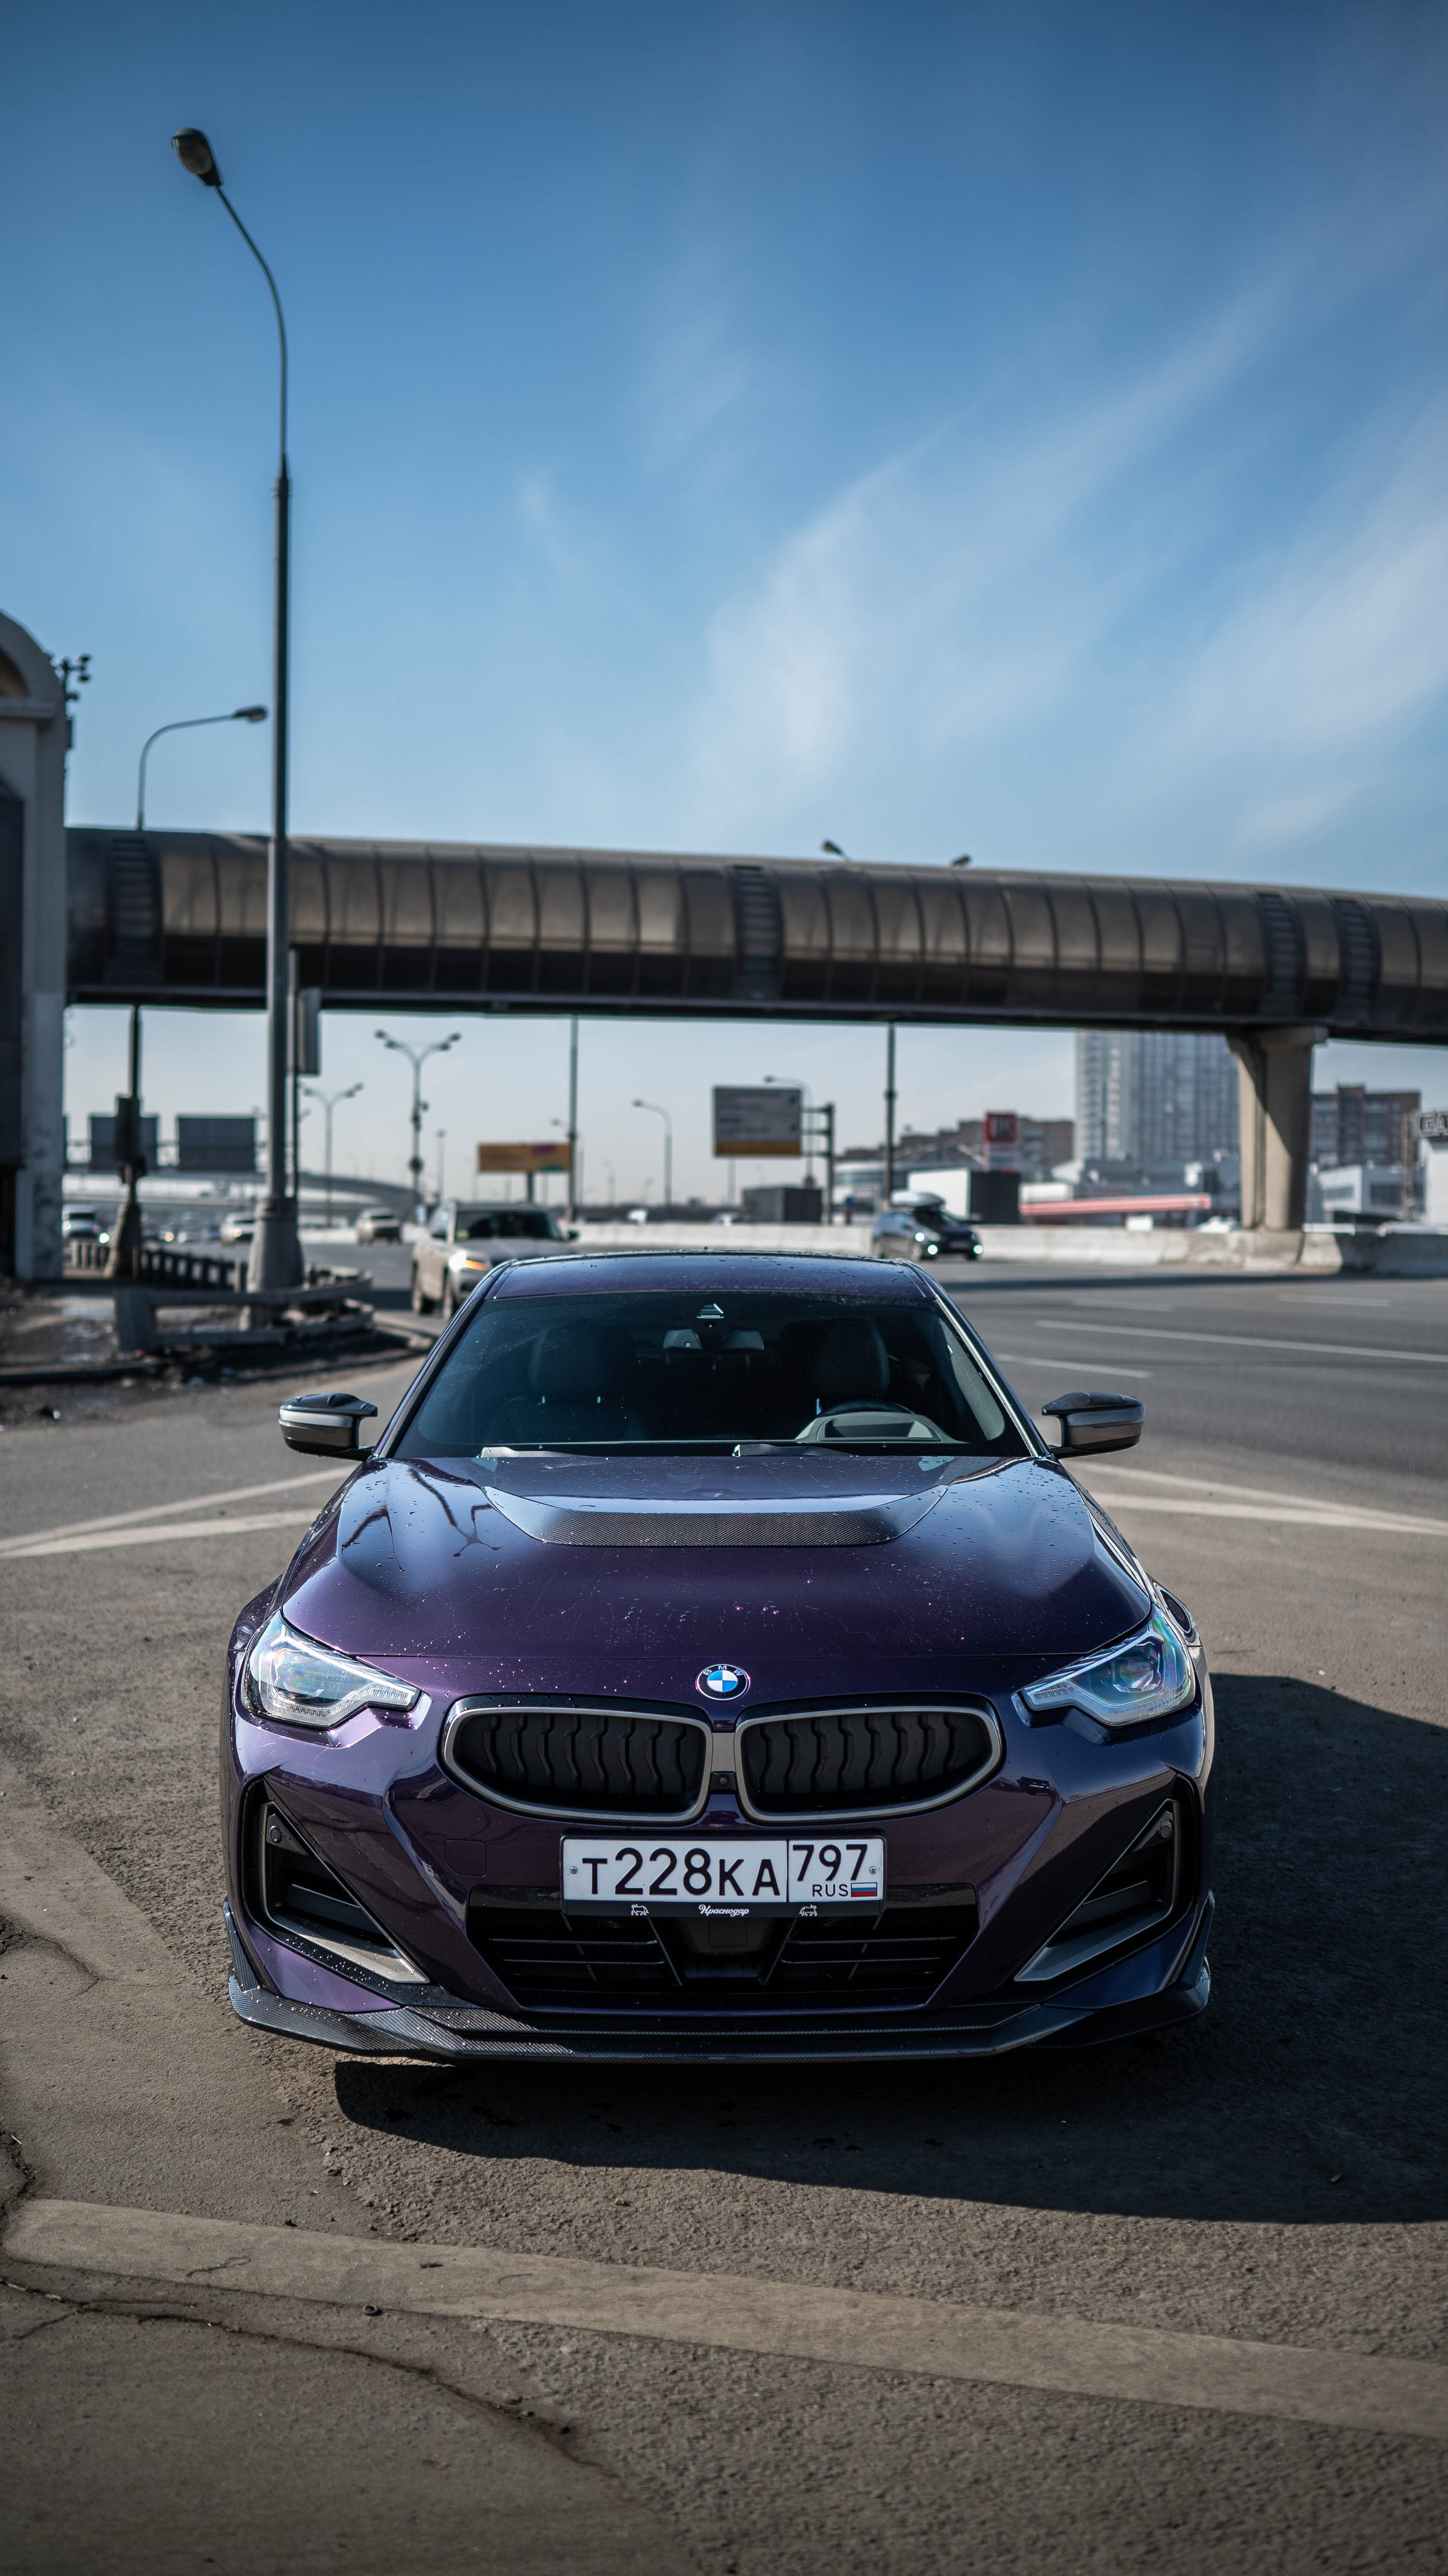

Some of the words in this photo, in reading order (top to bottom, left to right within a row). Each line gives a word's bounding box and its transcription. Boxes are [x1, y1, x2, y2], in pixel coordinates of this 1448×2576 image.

[702, 1665, 743, 1676] BMW
[792, 1844, 868, 1882] 797
[812, 1884, 849, 1897] RUS
[699, 1904, 749, 1918] Краснодар
